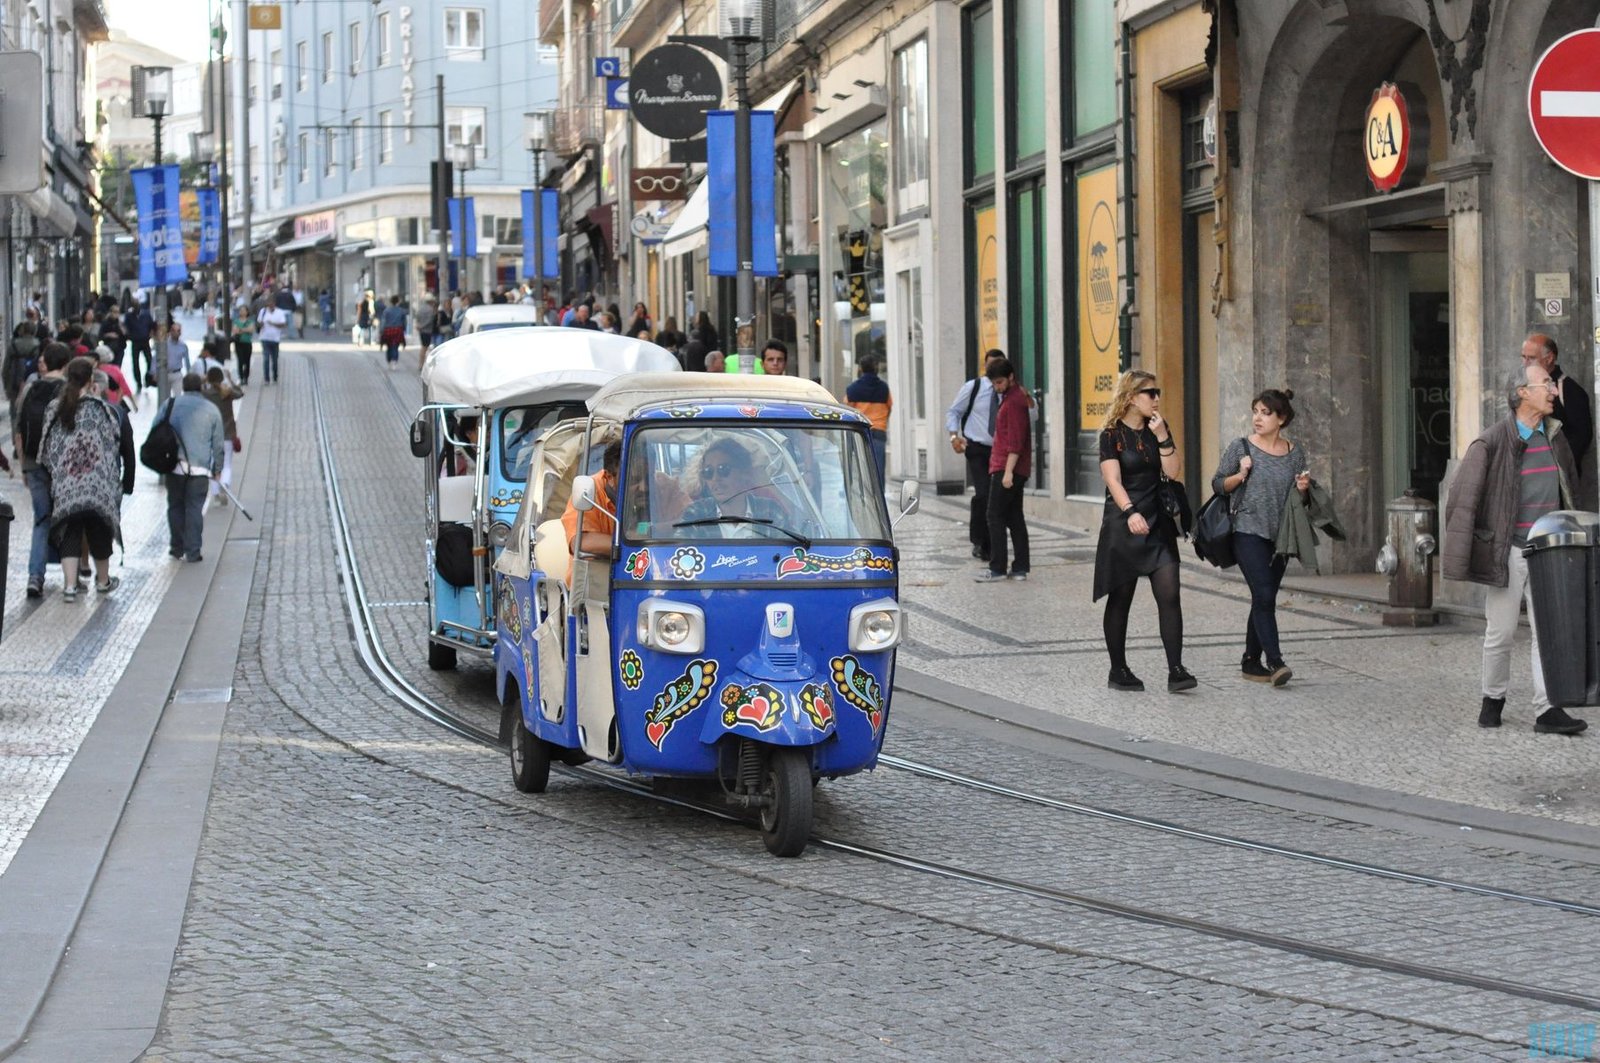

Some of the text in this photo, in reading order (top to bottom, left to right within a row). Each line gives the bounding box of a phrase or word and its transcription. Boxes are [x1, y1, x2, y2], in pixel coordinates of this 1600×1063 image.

[1369, 112, 1398, 160] C&A
[138, 224, 180, 249] vota
[1094, 374, 1113, 391] ABRE
